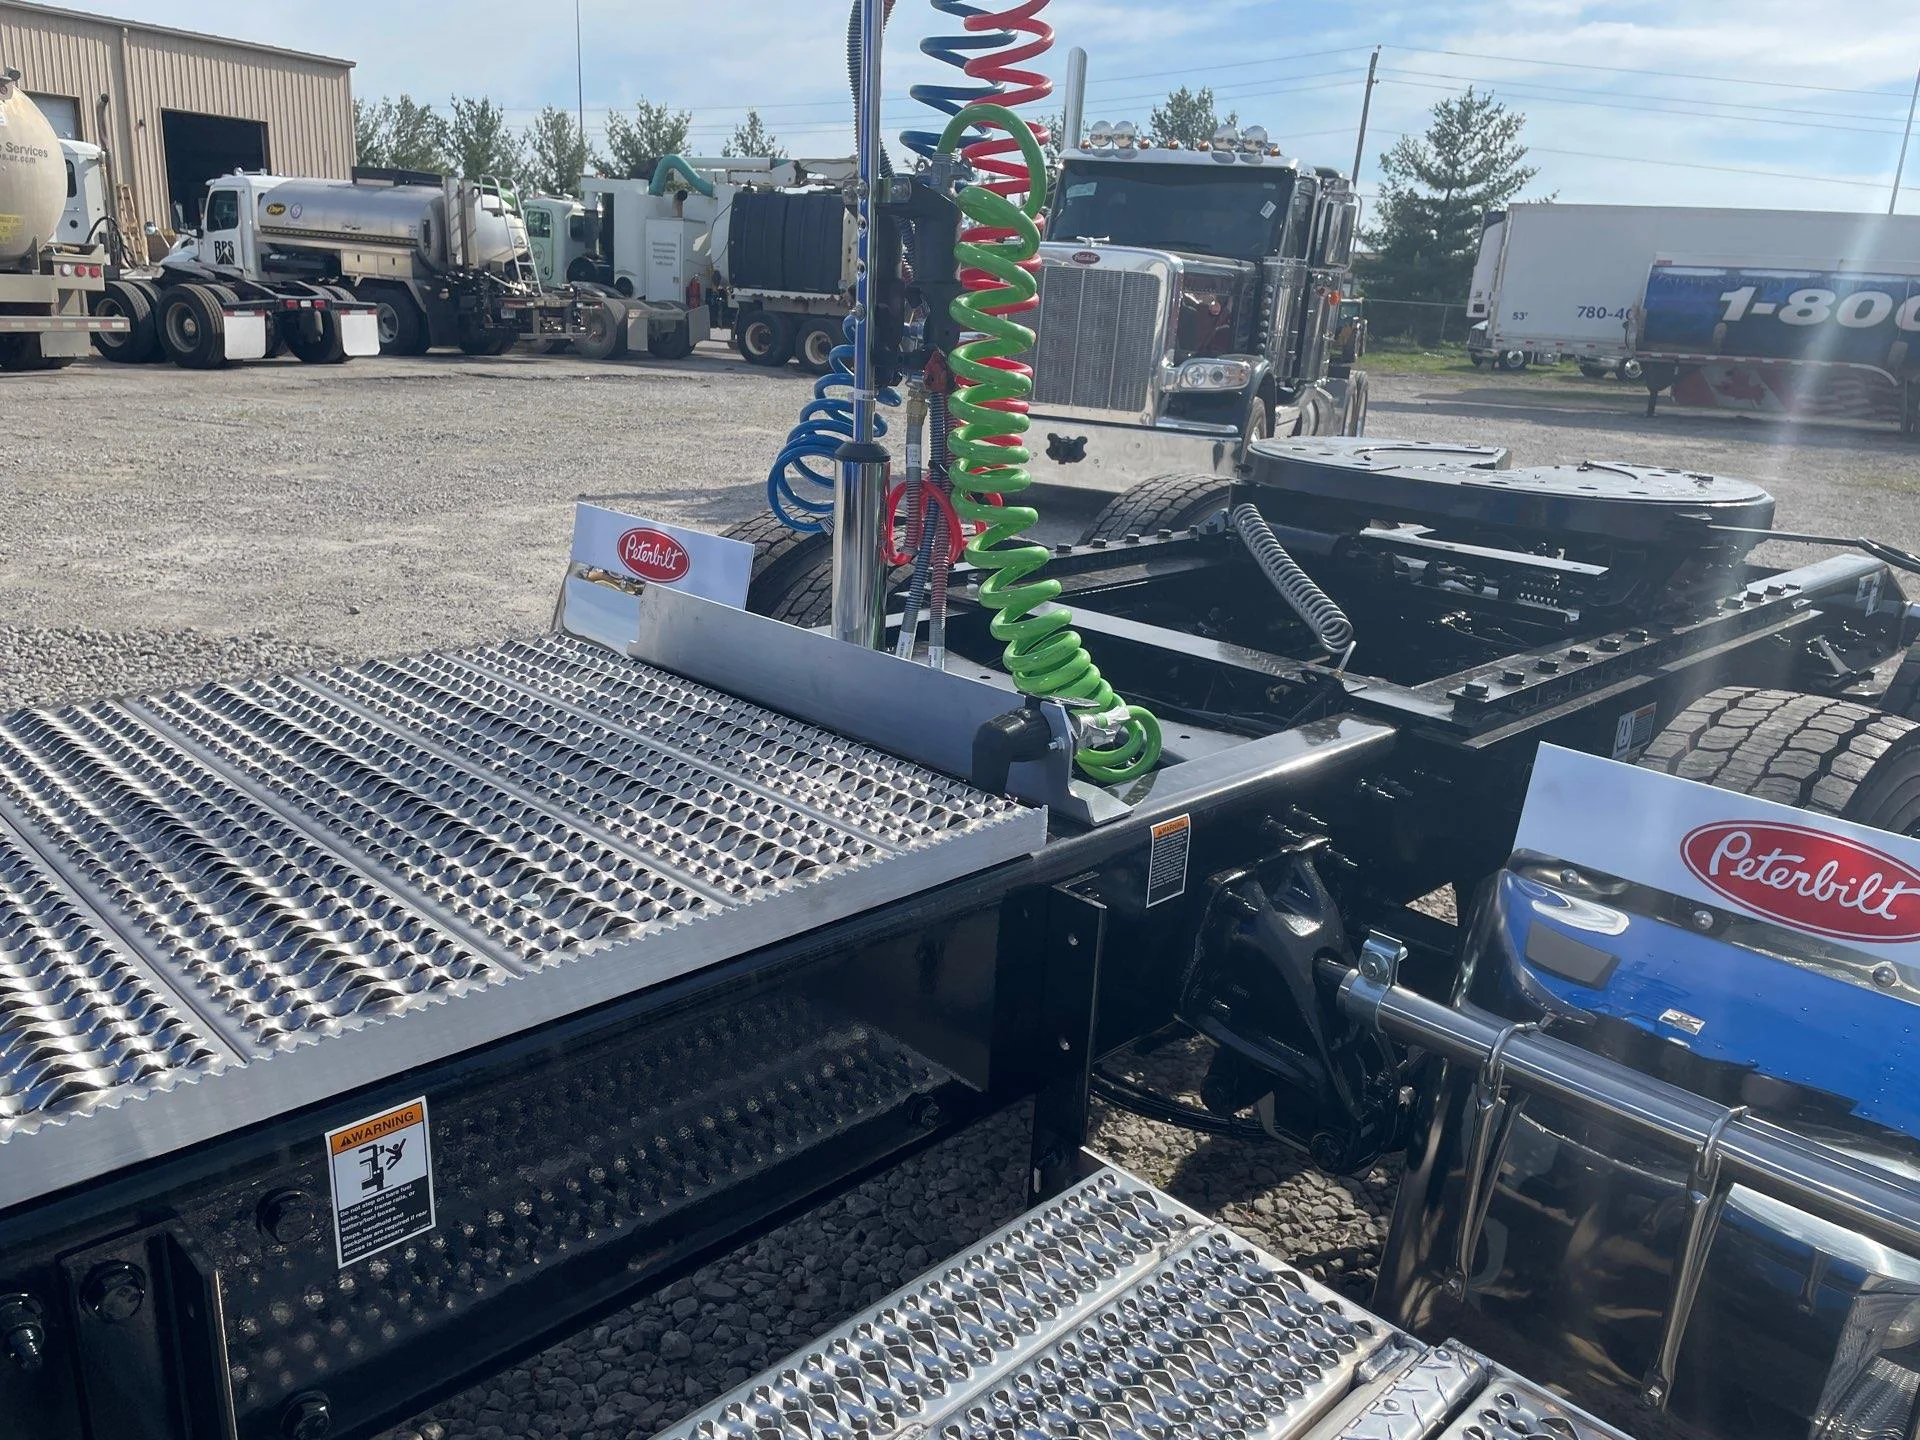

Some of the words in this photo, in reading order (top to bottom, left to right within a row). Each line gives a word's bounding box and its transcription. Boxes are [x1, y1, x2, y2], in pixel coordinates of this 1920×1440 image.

[5, 141, 48, 159] Services
[625, 534, 683, 570] Peterbilt
[1709, 831, 1920, 920] Peterbilt
[351, 1111, 414, 1141] WARNING
[350, 1205, 361, 1214] not
[361, 1200, 376, 1209] step
[400, 1184, 412, 1193] fuel
[360, 1208, 373, 1217] rear
[374, 1200, 392, 1210] frame
[362, 1217, 392, 1234] handhold
[392, 1212, 404, 1221] and
[373, 1229, 384, 1237] are
[384, 1216, 410, 1232] required
[415, 1210, 428, 1218] rear
[343, 1244, 366, 1257] access
